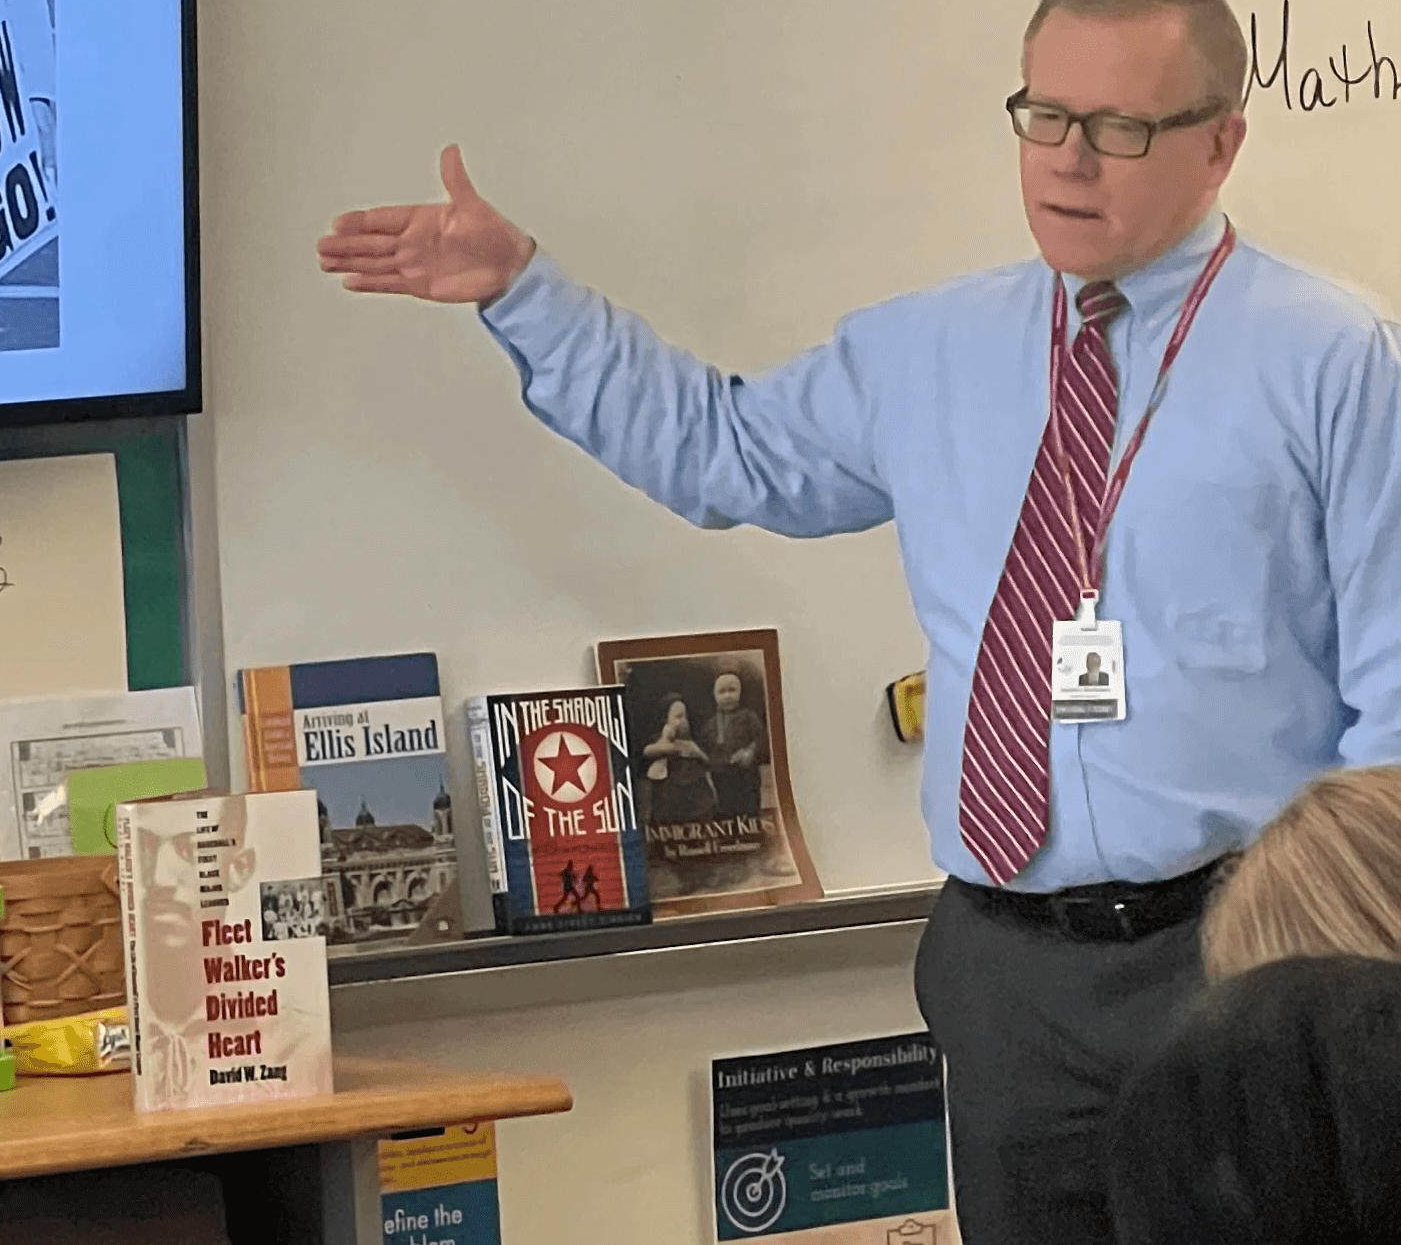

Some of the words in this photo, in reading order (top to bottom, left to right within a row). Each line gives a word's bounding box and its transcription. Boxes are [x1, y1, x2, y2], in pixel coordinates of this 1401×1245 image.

[304, 713, 353, 729] Arriving
[494, 702, 519, 768] IN
[519, 699, 551, 735] THE
[553, 695, 628, 758] SHADOW
[304, 729, 355, 761] Ellis
[363, 720, 438, 755] Island
[502, 776, 535, 840] OF
[543, 807, 587, 837] THE
[593, 766, 637, 833] SUN
[201, 919, 252, 946] Fleet
[204, 953, 286, 984] Walker's
[205, 990, 278, 1021] Divided
[208, 1030, 261, 1059] Heart
[209, 1066, 243, 1085] David
[244, 1066, 259, 1082] W.
[260, 1064, 287, 1081] Zang
[718, 1066, 798, 1089] Initiative
[804, 1060, 816, 1076] &
[822, 1043, 937, 1075] Responsibility
[837, 1157, 865, 1175] and
[385, 1209, 428, 1234] efine
[434, 1203, 462, 1227] the
